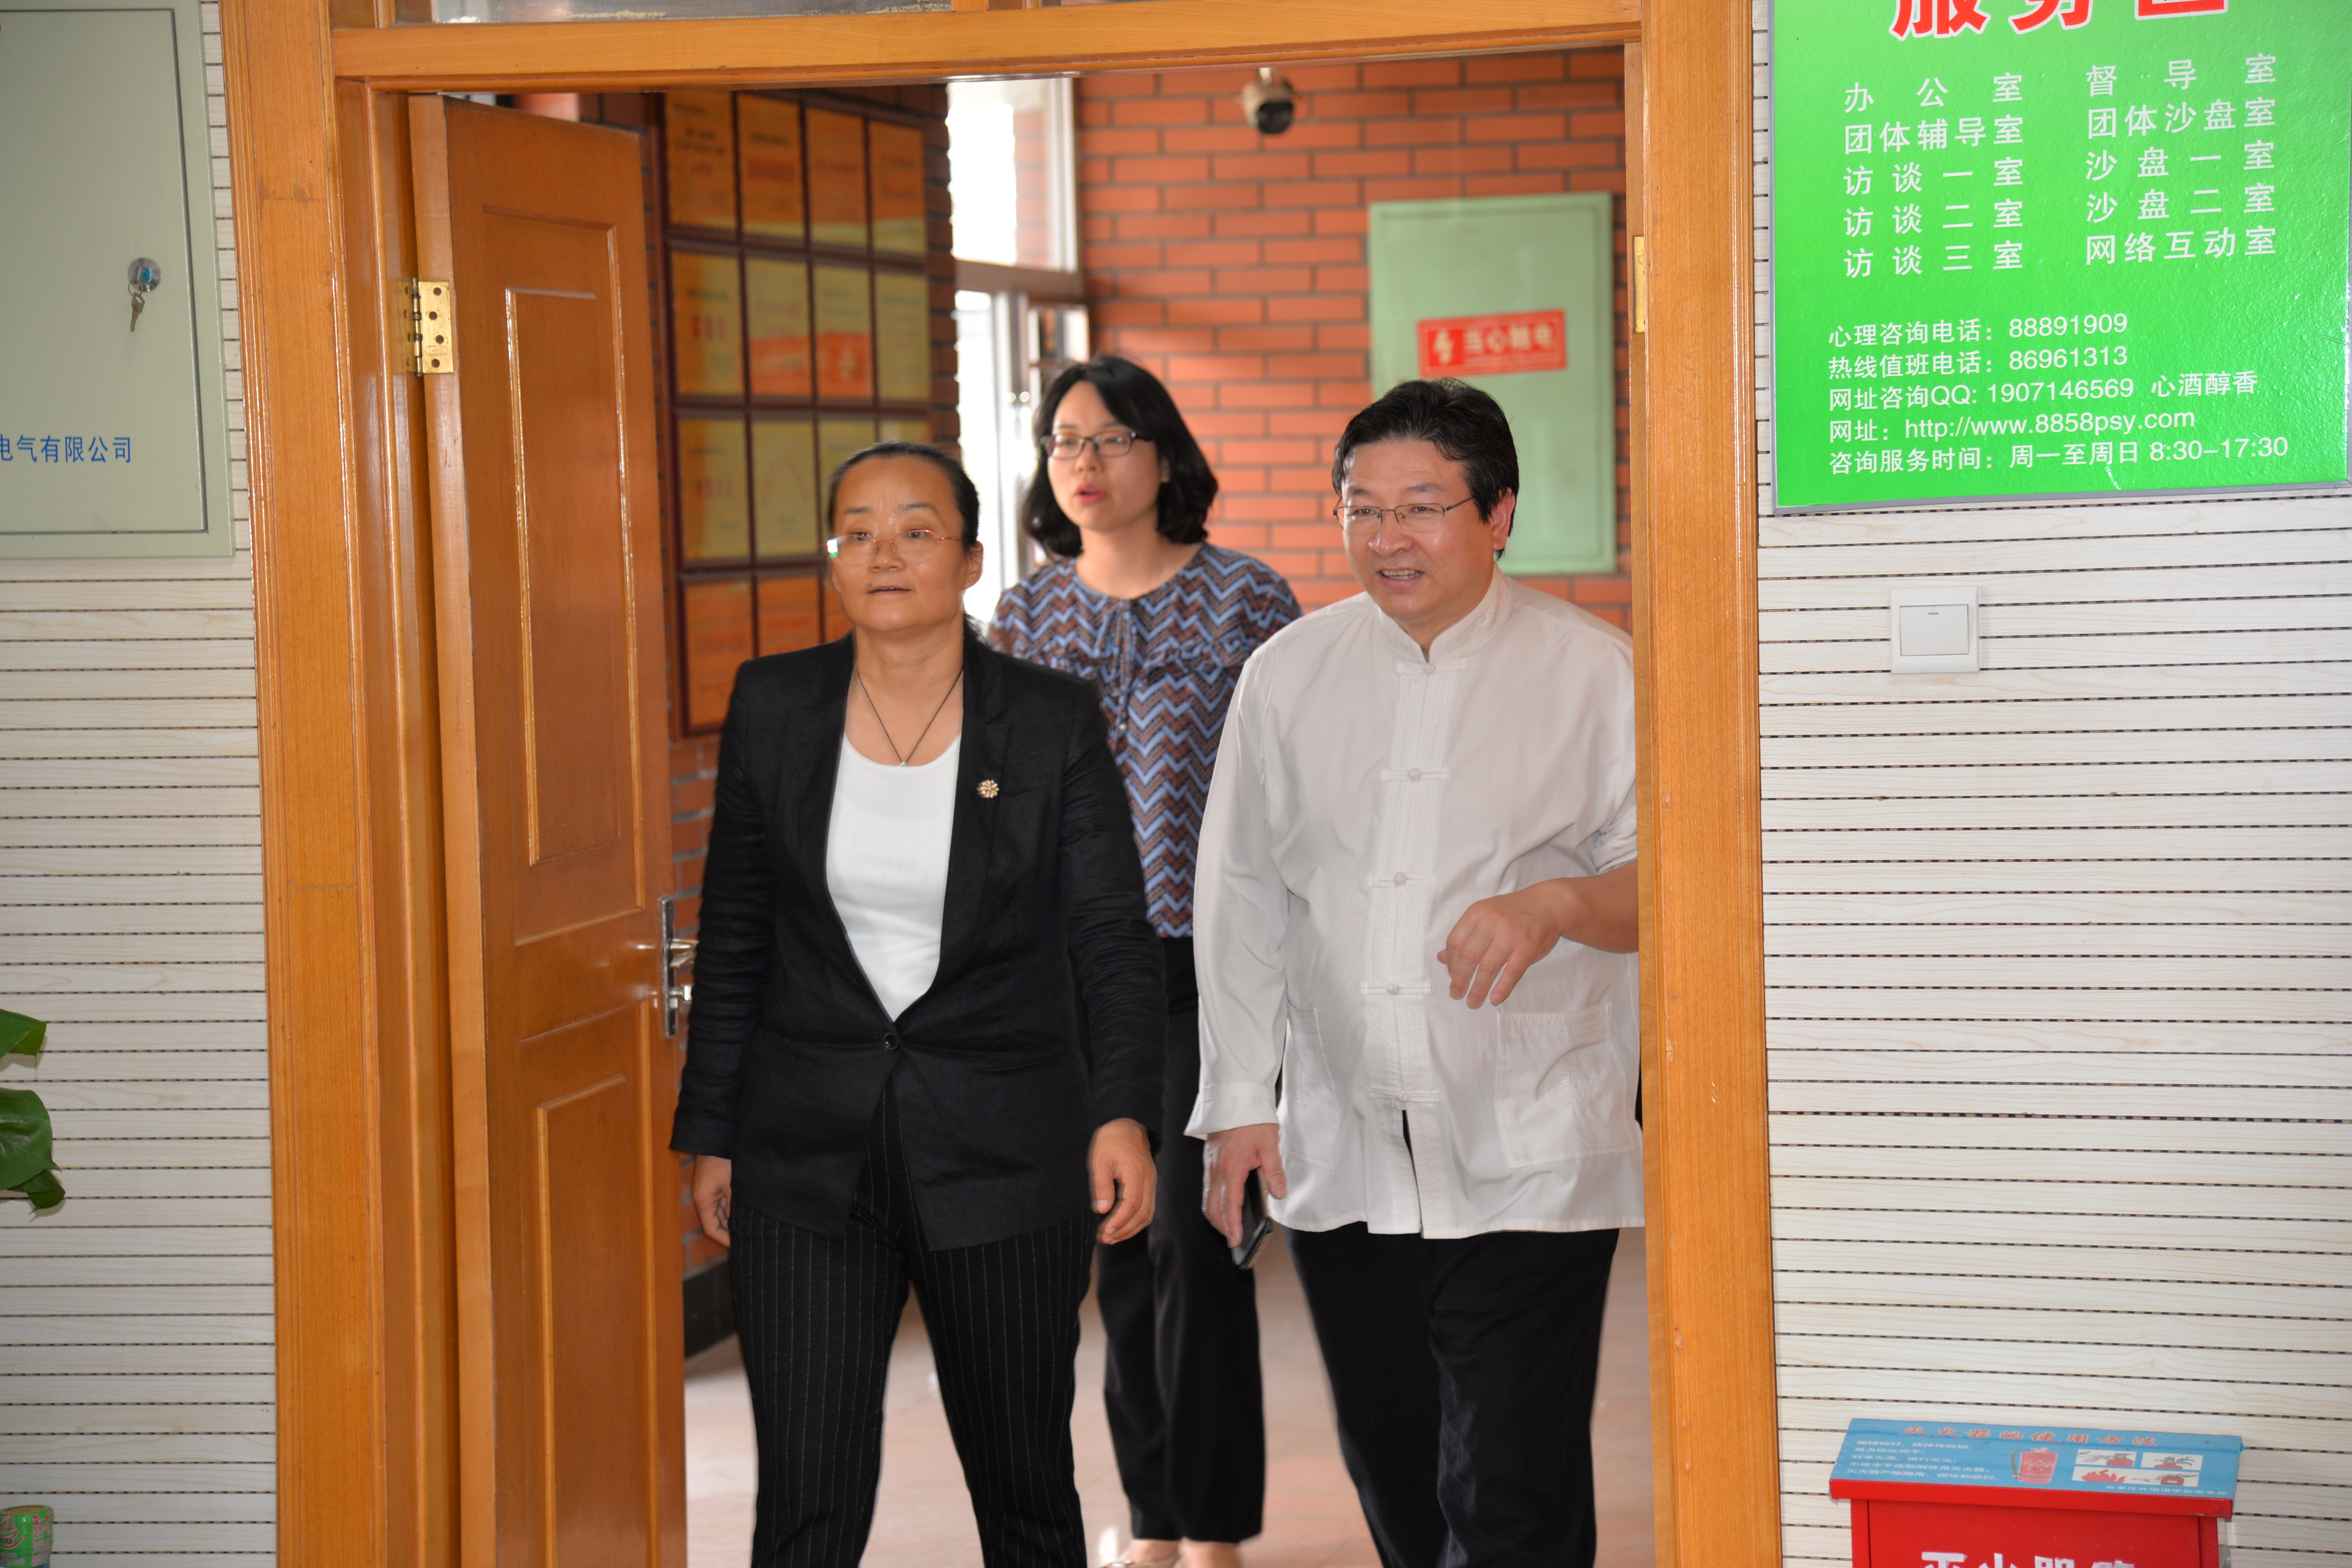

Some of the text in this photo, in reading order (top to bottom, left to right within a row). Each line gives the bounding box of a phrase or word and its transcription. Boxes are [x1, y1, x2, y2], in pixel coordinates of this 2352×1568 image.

[1844, 72, 2023, 113] 办公室
[2086, 53, 2276, 97] 督导室
[1844, 114, 2023, 155] 团体辅导室
[2087, 96, 2275, 139] 团体沙盘室
[1843, 156, 2023, 196] 访谈一室
[2085, 139, 2275, 181] 沙盘一室
[1843, 199, 2023, 238] 访谈二室
[2086, 182, 2275, 223] 沙盘二室
[1843, 240, 2023, 278] 访谈三室
[2086, 225, 2276, 265] 网络互动室
[1988, 378, 2134, 402] 1907146569
[2151, 370, 2258, 398] 心酒醇香
[1900, 1426, 2157, 1446] 灭火器的使用方法
